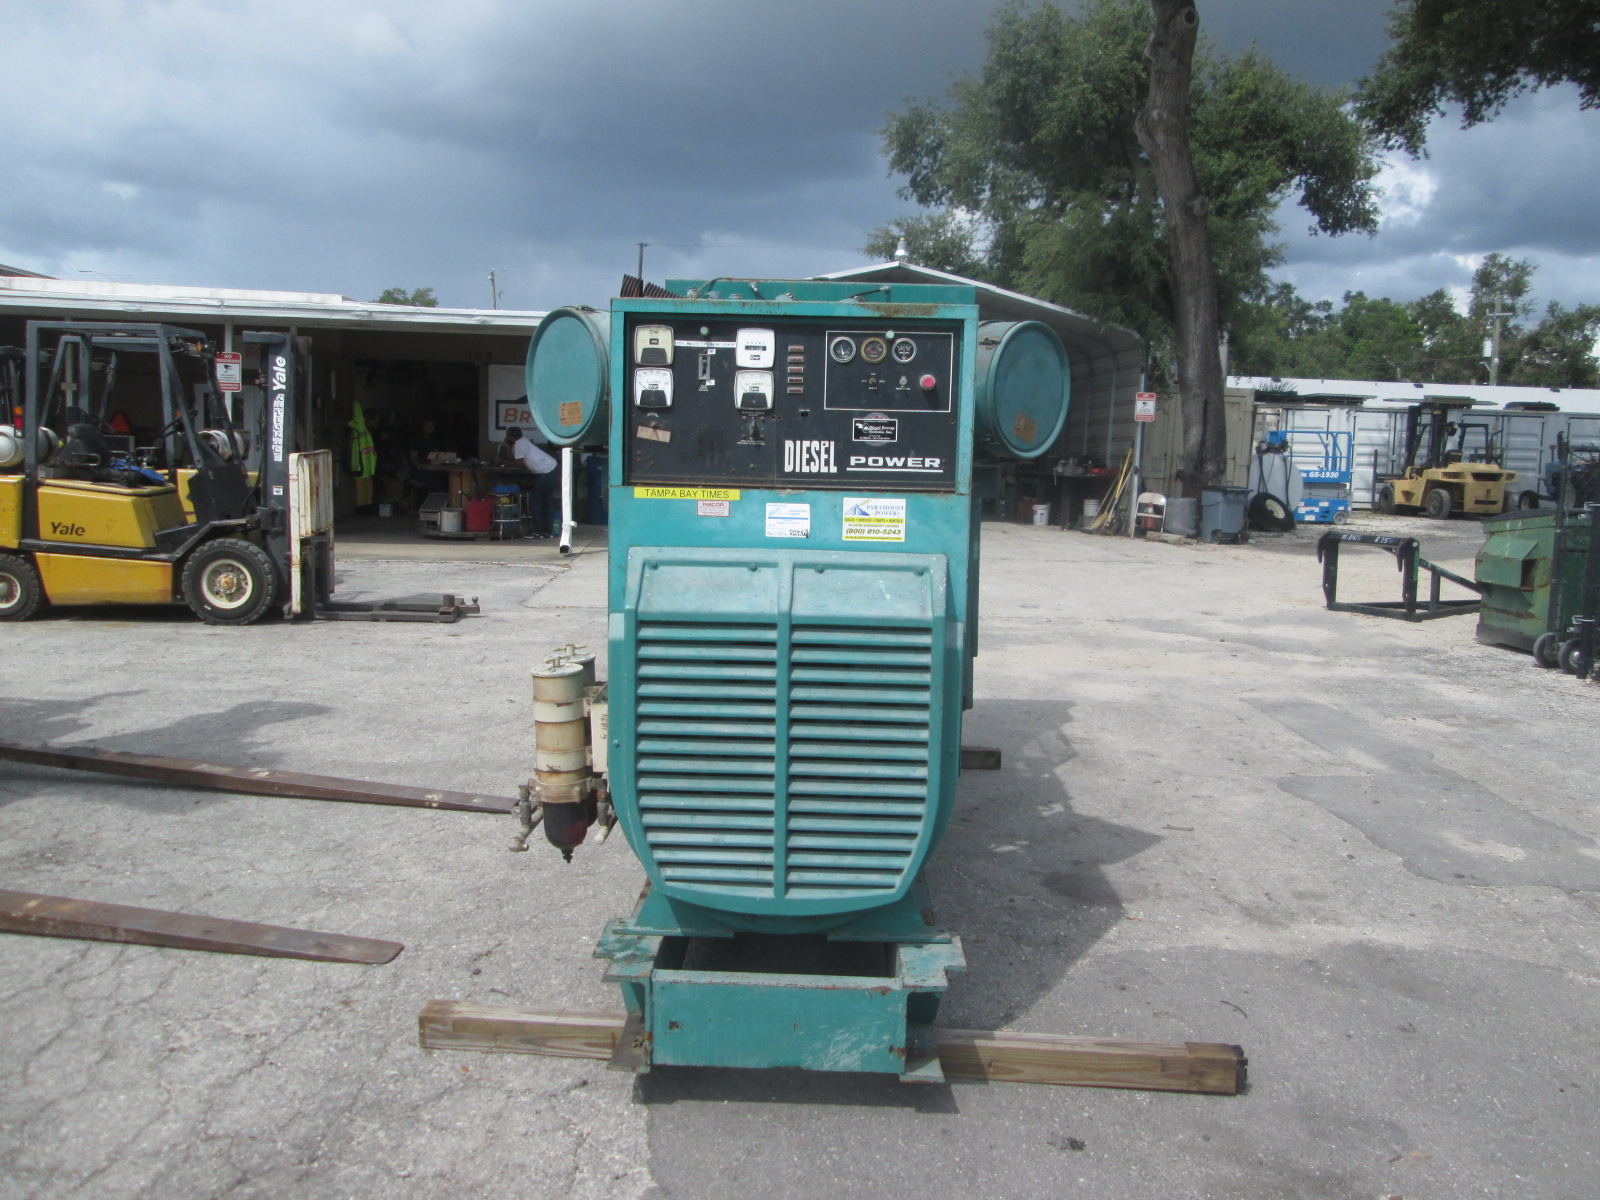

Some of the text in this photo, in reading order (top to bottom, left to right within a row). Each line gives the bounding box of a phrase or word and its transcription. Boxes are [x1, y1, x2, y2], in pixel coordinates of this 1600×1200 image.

[273, 356, 287, 390] Yale
[784, 440, 837, 473] DIESEL
[850, 456, 941, 468] POWER
[645, 488, 730, 499] TAMPA BAY TIMES
[51, 521, 86, 537] Yale
[846, 527, 902, 536] (800) 810-5243
